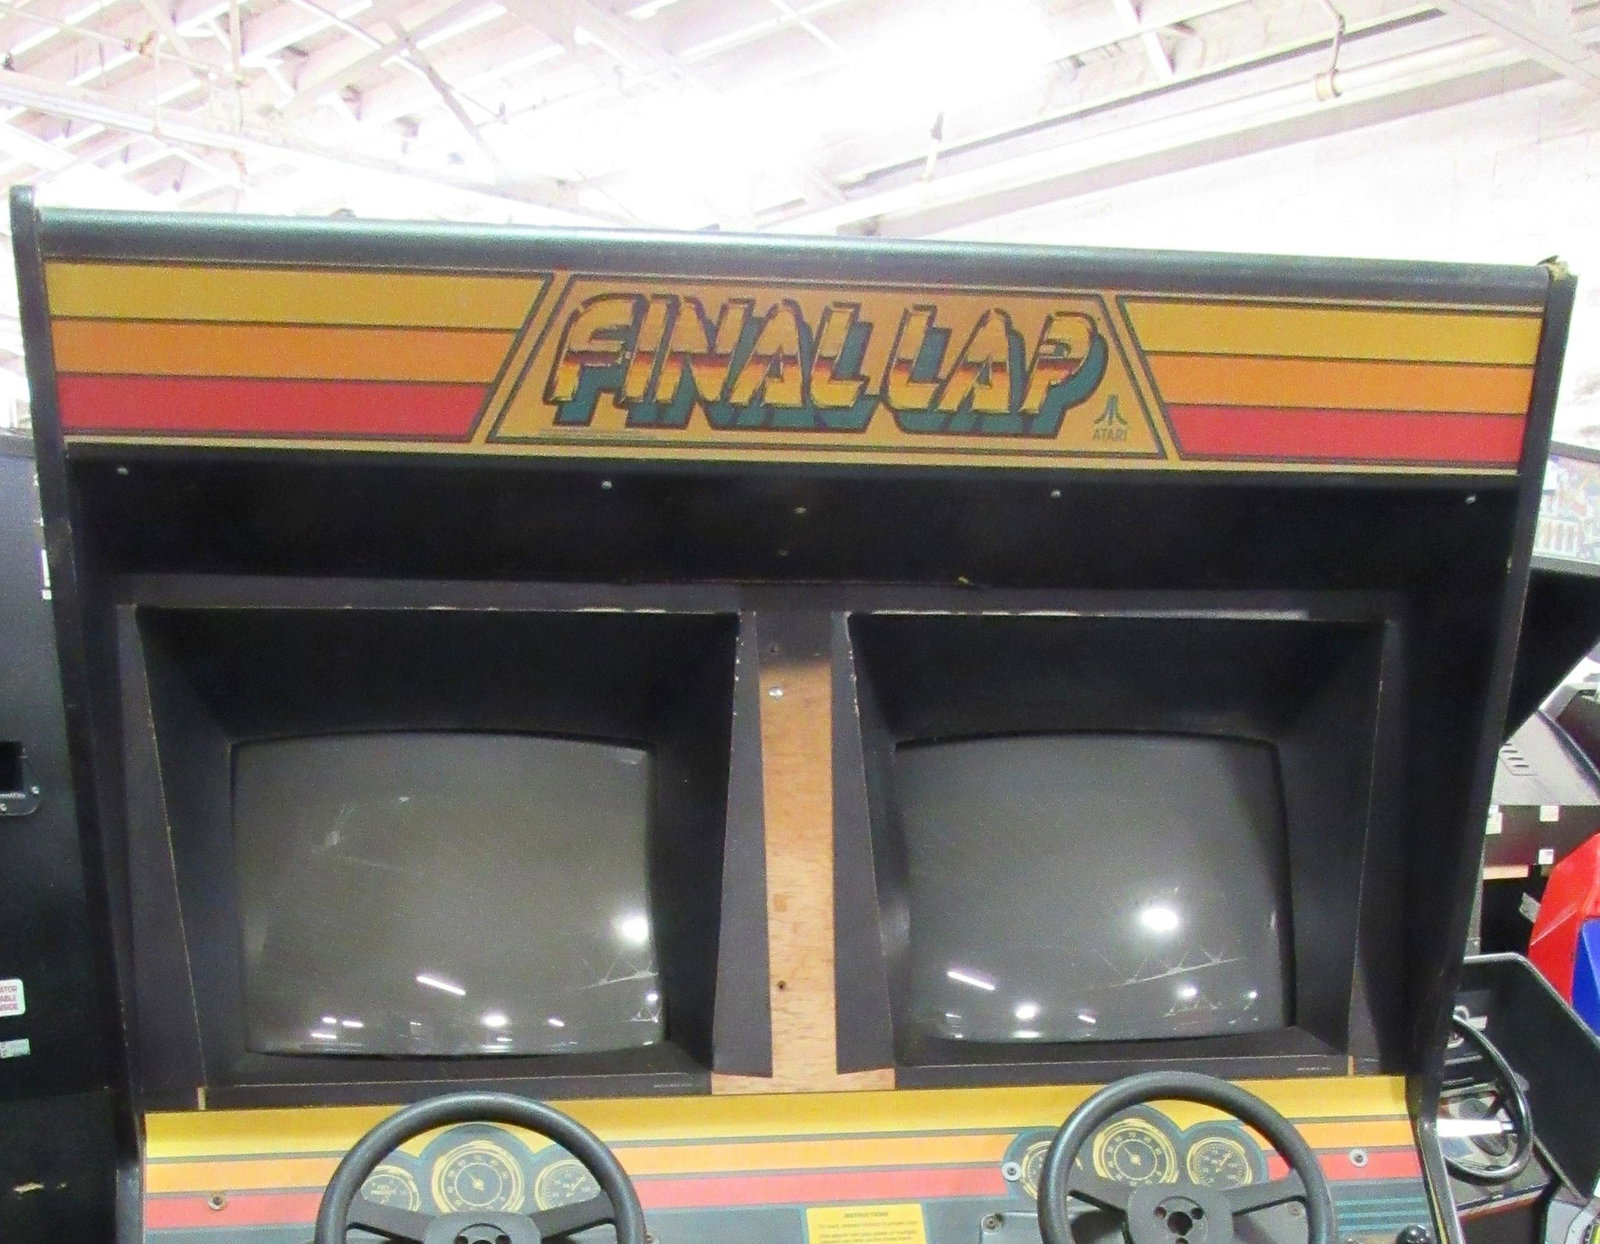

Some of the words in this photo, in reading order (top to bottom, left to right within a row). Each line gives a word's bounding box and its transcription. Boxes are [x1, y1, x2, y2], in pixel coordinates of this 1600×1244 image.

[545, 292, 873, 432] FINAL
[884, 303, 1107, 437] LAP
[1092, 427, 1128, 443] ATARI
